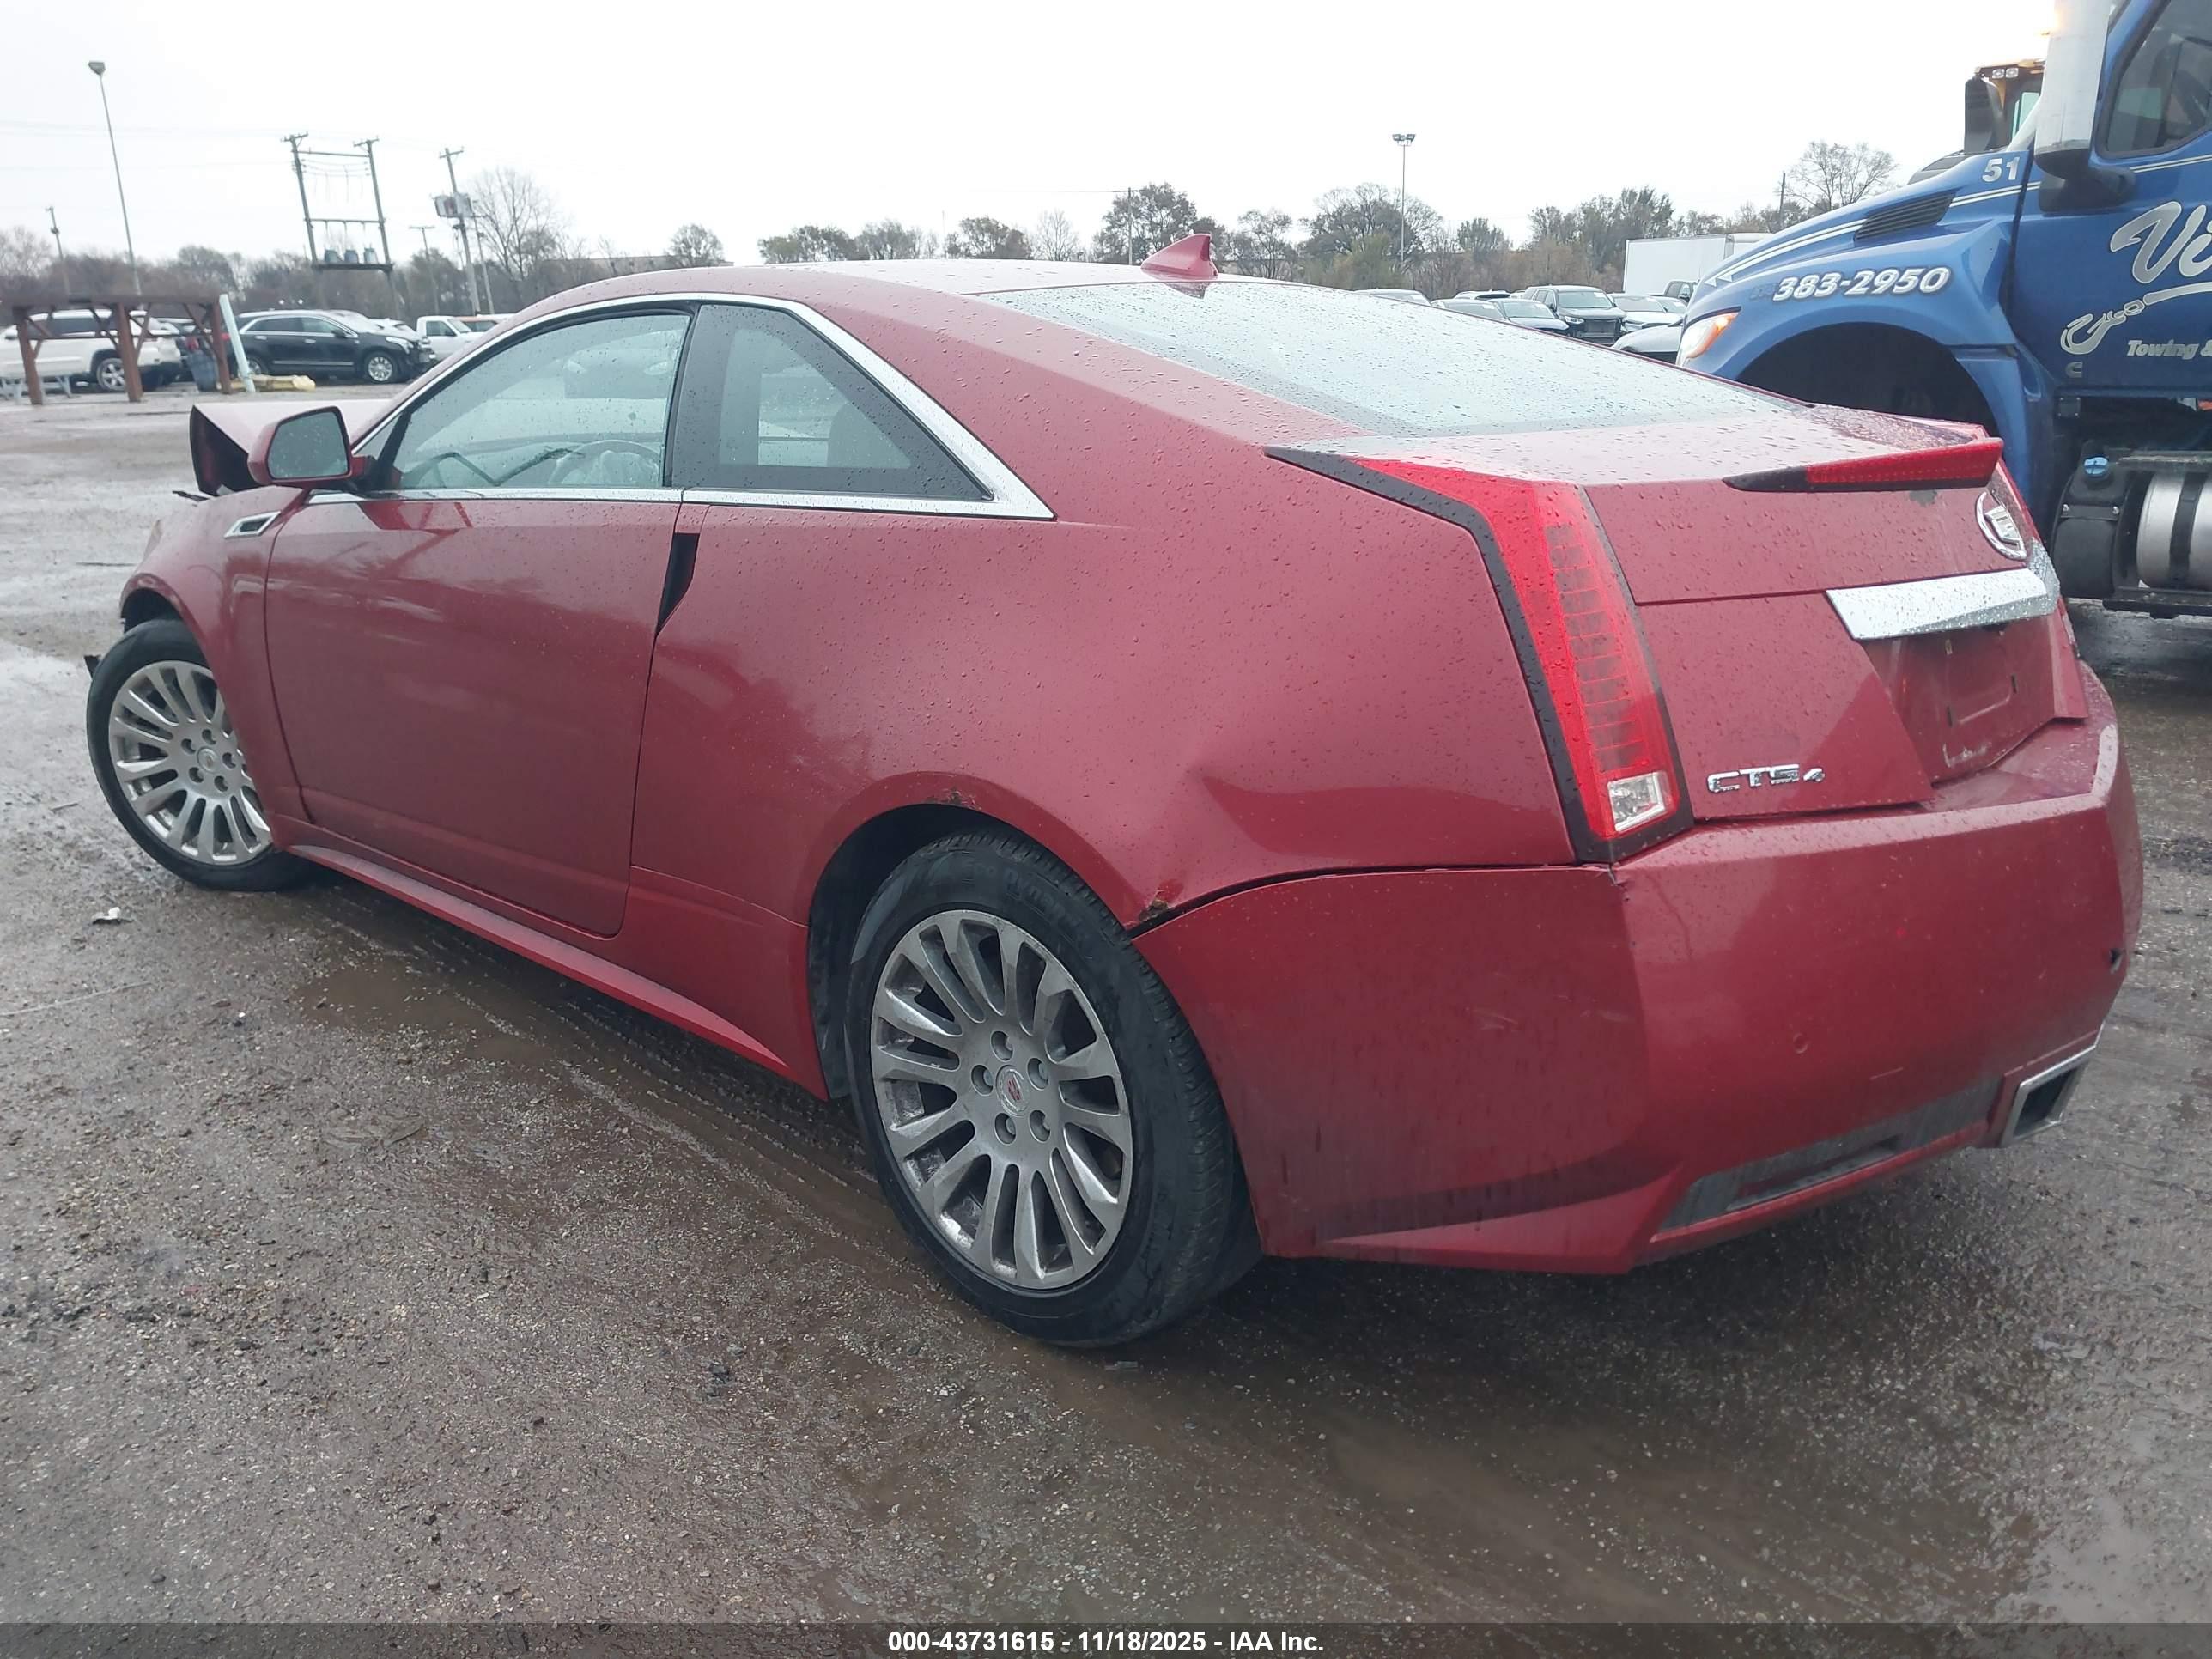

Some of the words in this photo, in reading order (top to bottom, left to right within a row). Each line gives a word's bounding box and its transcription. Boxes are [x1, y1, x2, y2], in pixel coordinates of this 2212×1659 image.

[1982, 157, 2020, 183] 51
[1772, 266, 1952, 302] 383-2950
[2127, 338, 2198, 360] Towing
